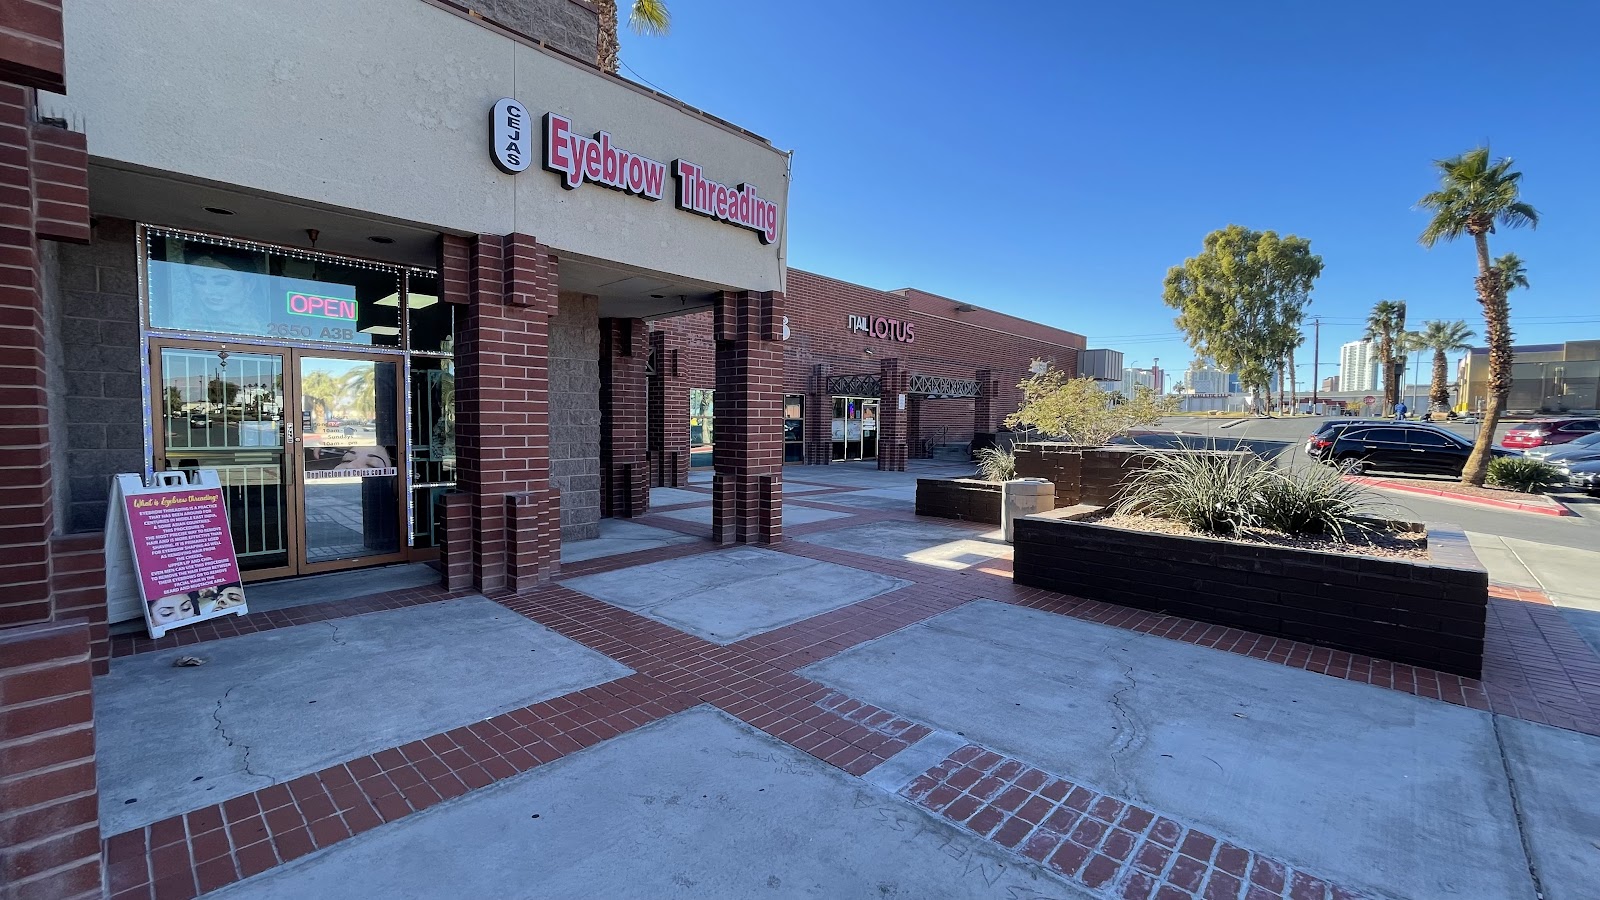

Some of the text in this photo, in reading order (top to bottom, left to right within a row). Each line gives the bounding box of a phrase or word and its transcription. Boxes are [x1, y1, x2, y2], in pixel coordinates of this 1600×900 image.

[506, 105, 521, 166] CEJAS
[551, 117, 777, 242] Eyebrow Threading
[290, 294, 355, 319] OPEN
[267, 322, 353, 340] 2650 A3B
[869, 315, 915, 343] LOTUS
[161, 496, 188, 507] Eyebrow
